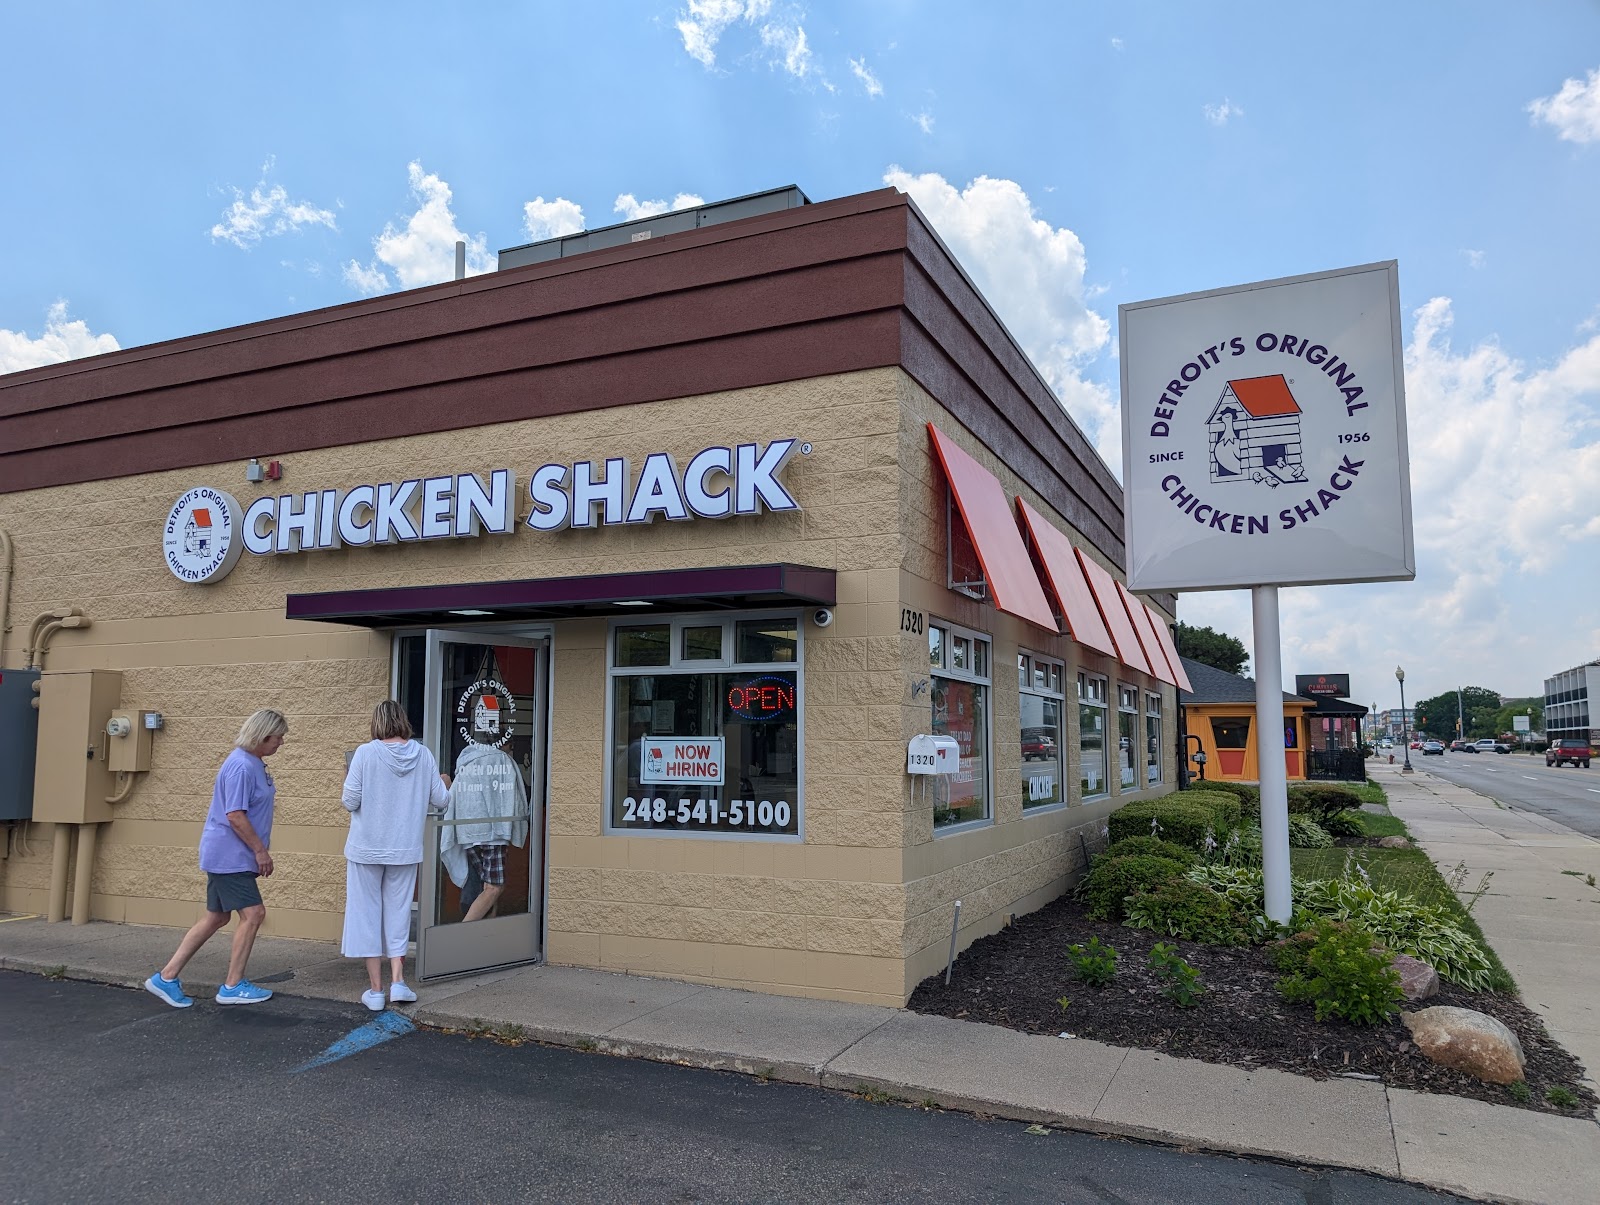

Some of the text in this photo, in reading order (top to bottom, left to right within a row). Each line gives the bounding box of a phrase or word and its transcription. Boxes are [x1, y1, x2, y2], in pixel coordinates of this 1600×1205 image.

[1151, 332, 1369, 437] DETROIT'S ORIGINAL
[1337, 433, 1371, 444] 1956
[1149, 451, 1184, 464] SINCE
[241, 437, 801, 556] CHICKEN SHACK
[1161, 454, 1366, 535] CHICKEN SHACK
[167, 489, 231, 534] DETROIT'S ORIGINAL
[168, 546, 227, 579] CHICKEN SHACK
[900, 608, 923, 636] 1320
[457, 680, 516, 714] DETROIT'S ORIGINAL
[728, 687, 794, 709] OPEN
[460, 726, 515, 751] CHICKEN SHACK
[675, 745, 711, 760] NOW
[910, 754, 935, 766] 1320
[459, 764, 512, 776] OPEN DAILY
[666, 761, 719, 778] HIRING
[622, 797, 791, 827] 248-541-5100
